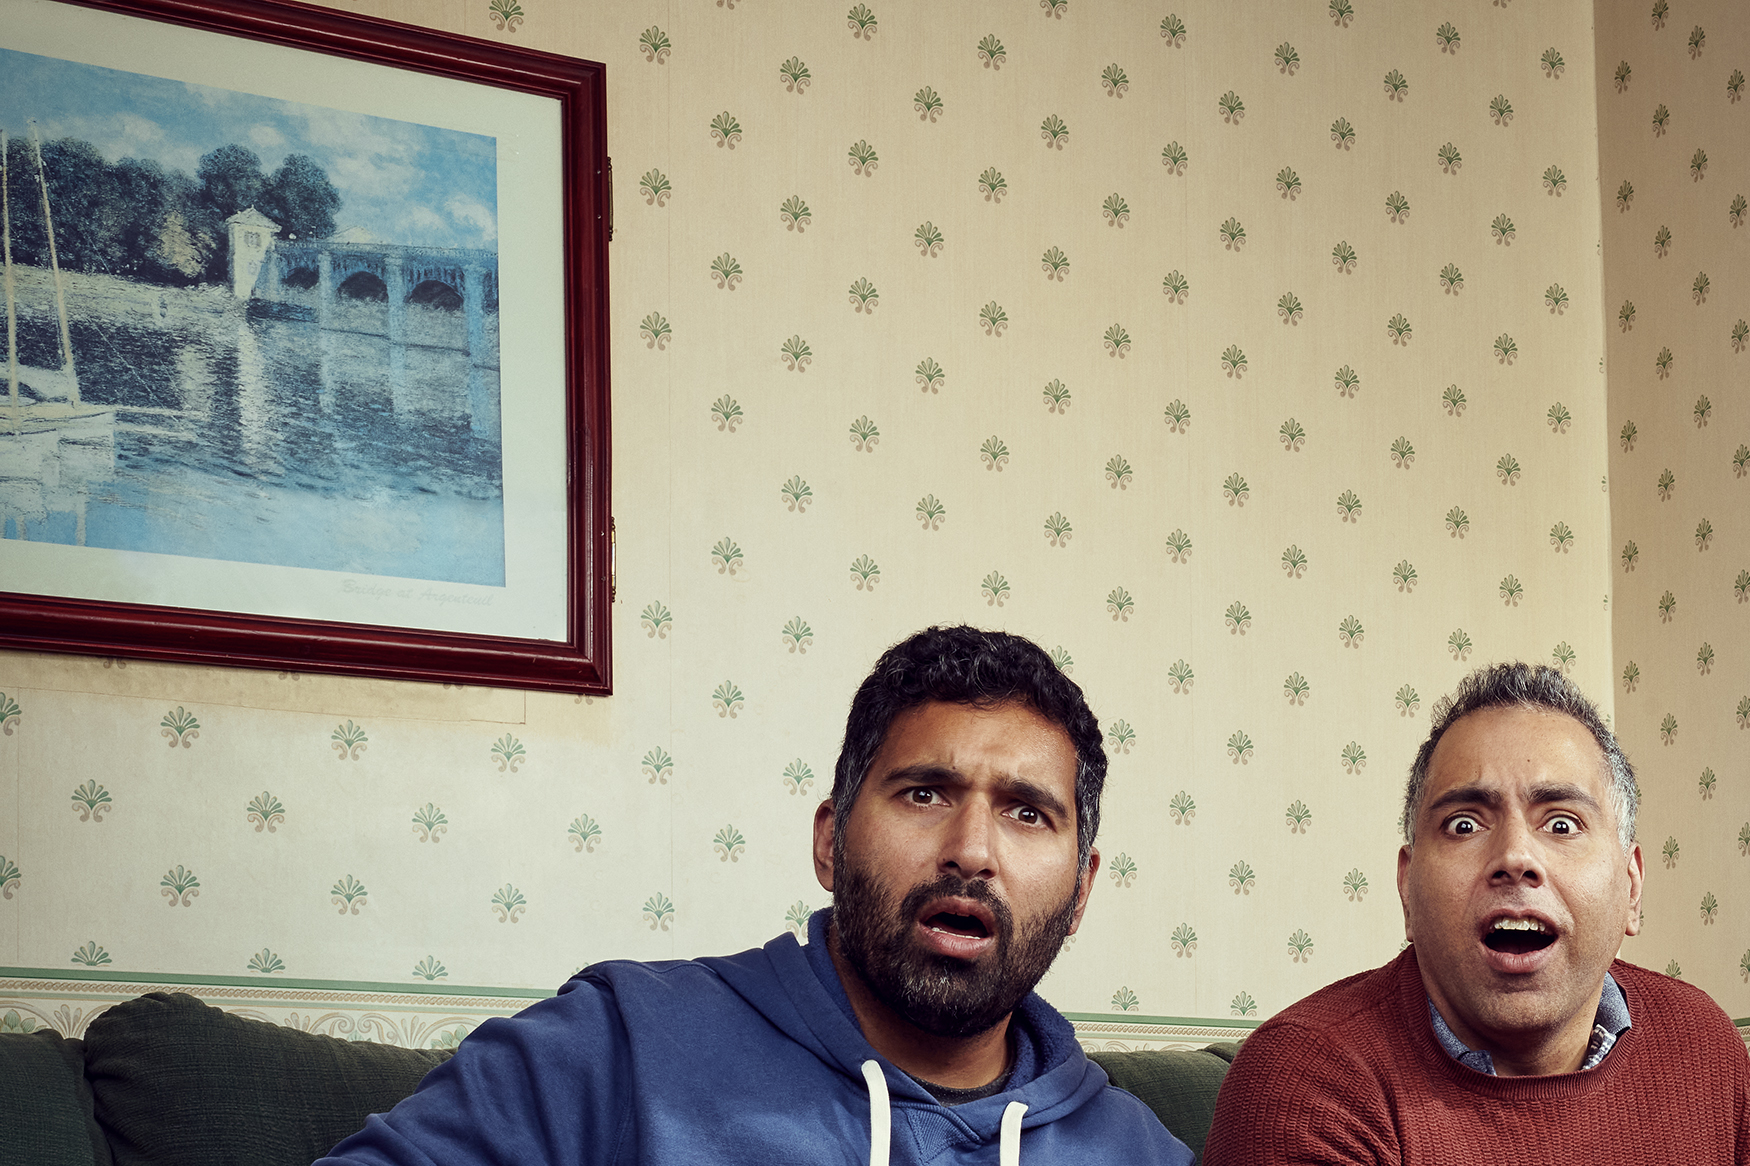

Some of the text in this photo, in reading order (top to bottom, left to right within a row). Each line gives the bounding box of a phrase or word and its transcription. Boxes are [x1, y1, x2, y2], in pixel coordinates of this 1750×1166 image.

[340, 578, 494, 607] Bridge at Argenteuil
